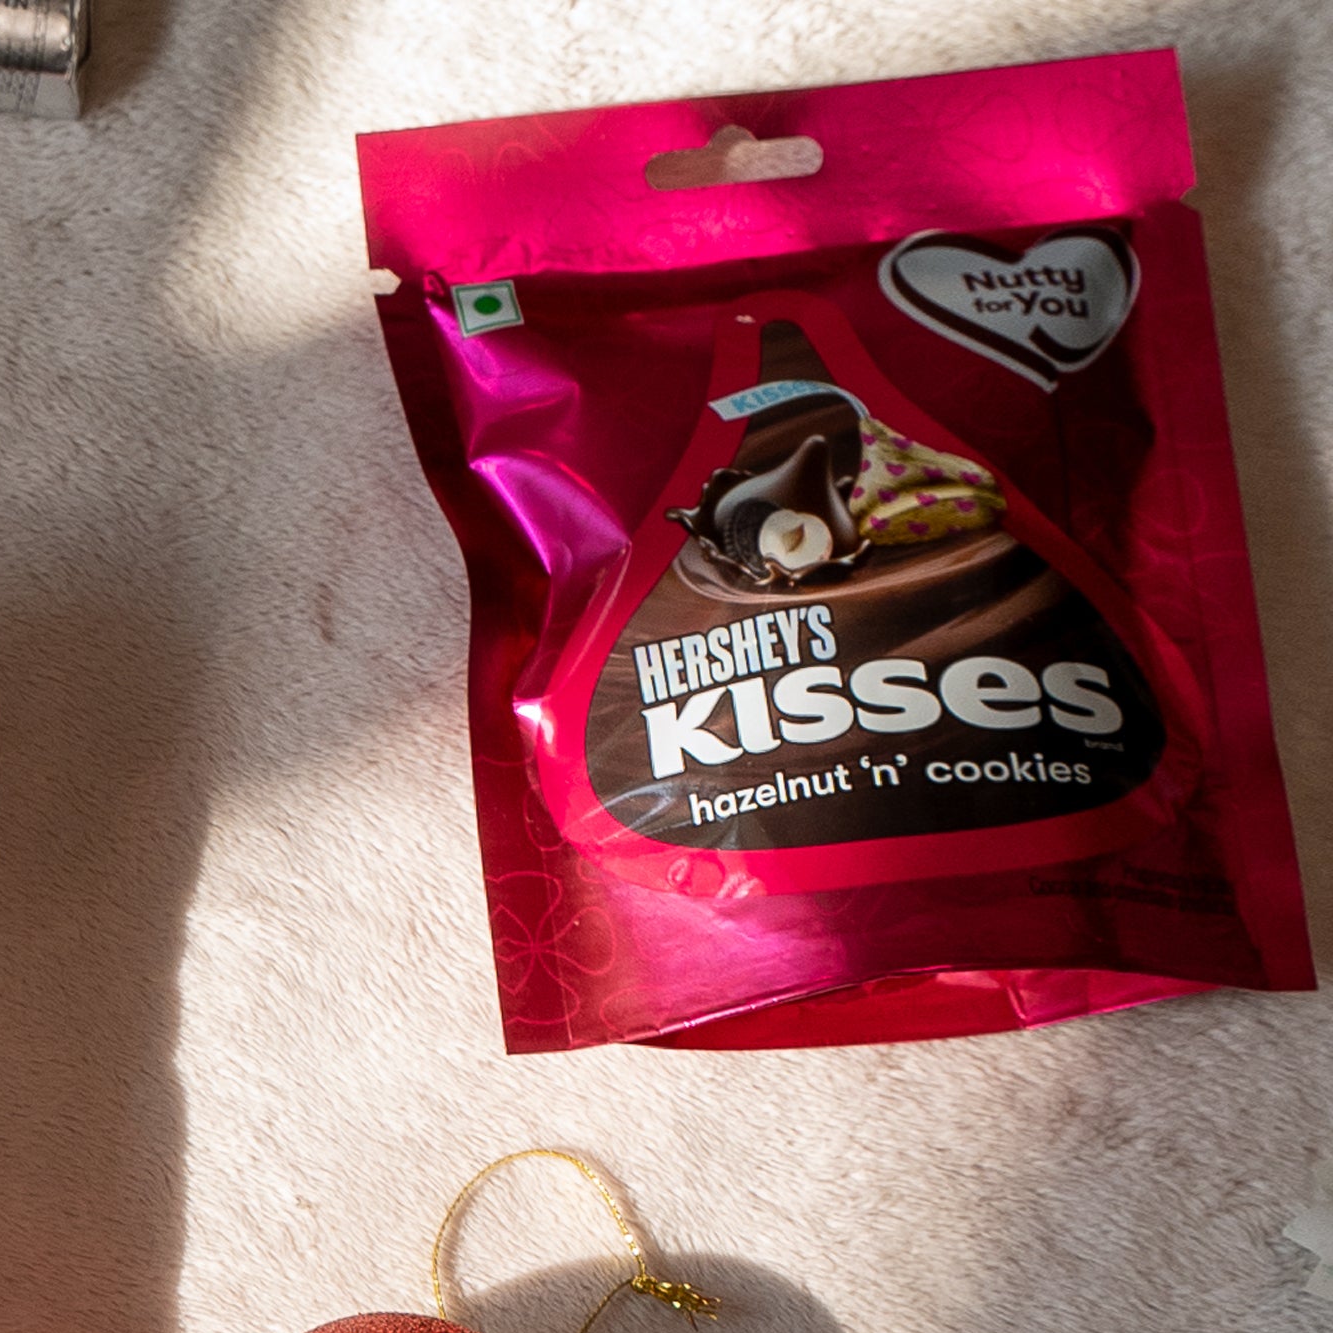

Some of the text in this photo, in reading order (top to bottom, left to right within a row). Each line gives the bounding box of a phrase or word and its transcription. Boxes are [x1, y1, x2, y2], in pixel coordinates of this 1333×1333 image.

[961, 265, 1087, 294] Nutty
[974, 291, 1090, 319] for You
[632, 604, 838, 704] HERSHEY'S
[688, 763, 853, 827] hazelnut
[925, 752, 1093, 786] cookies
